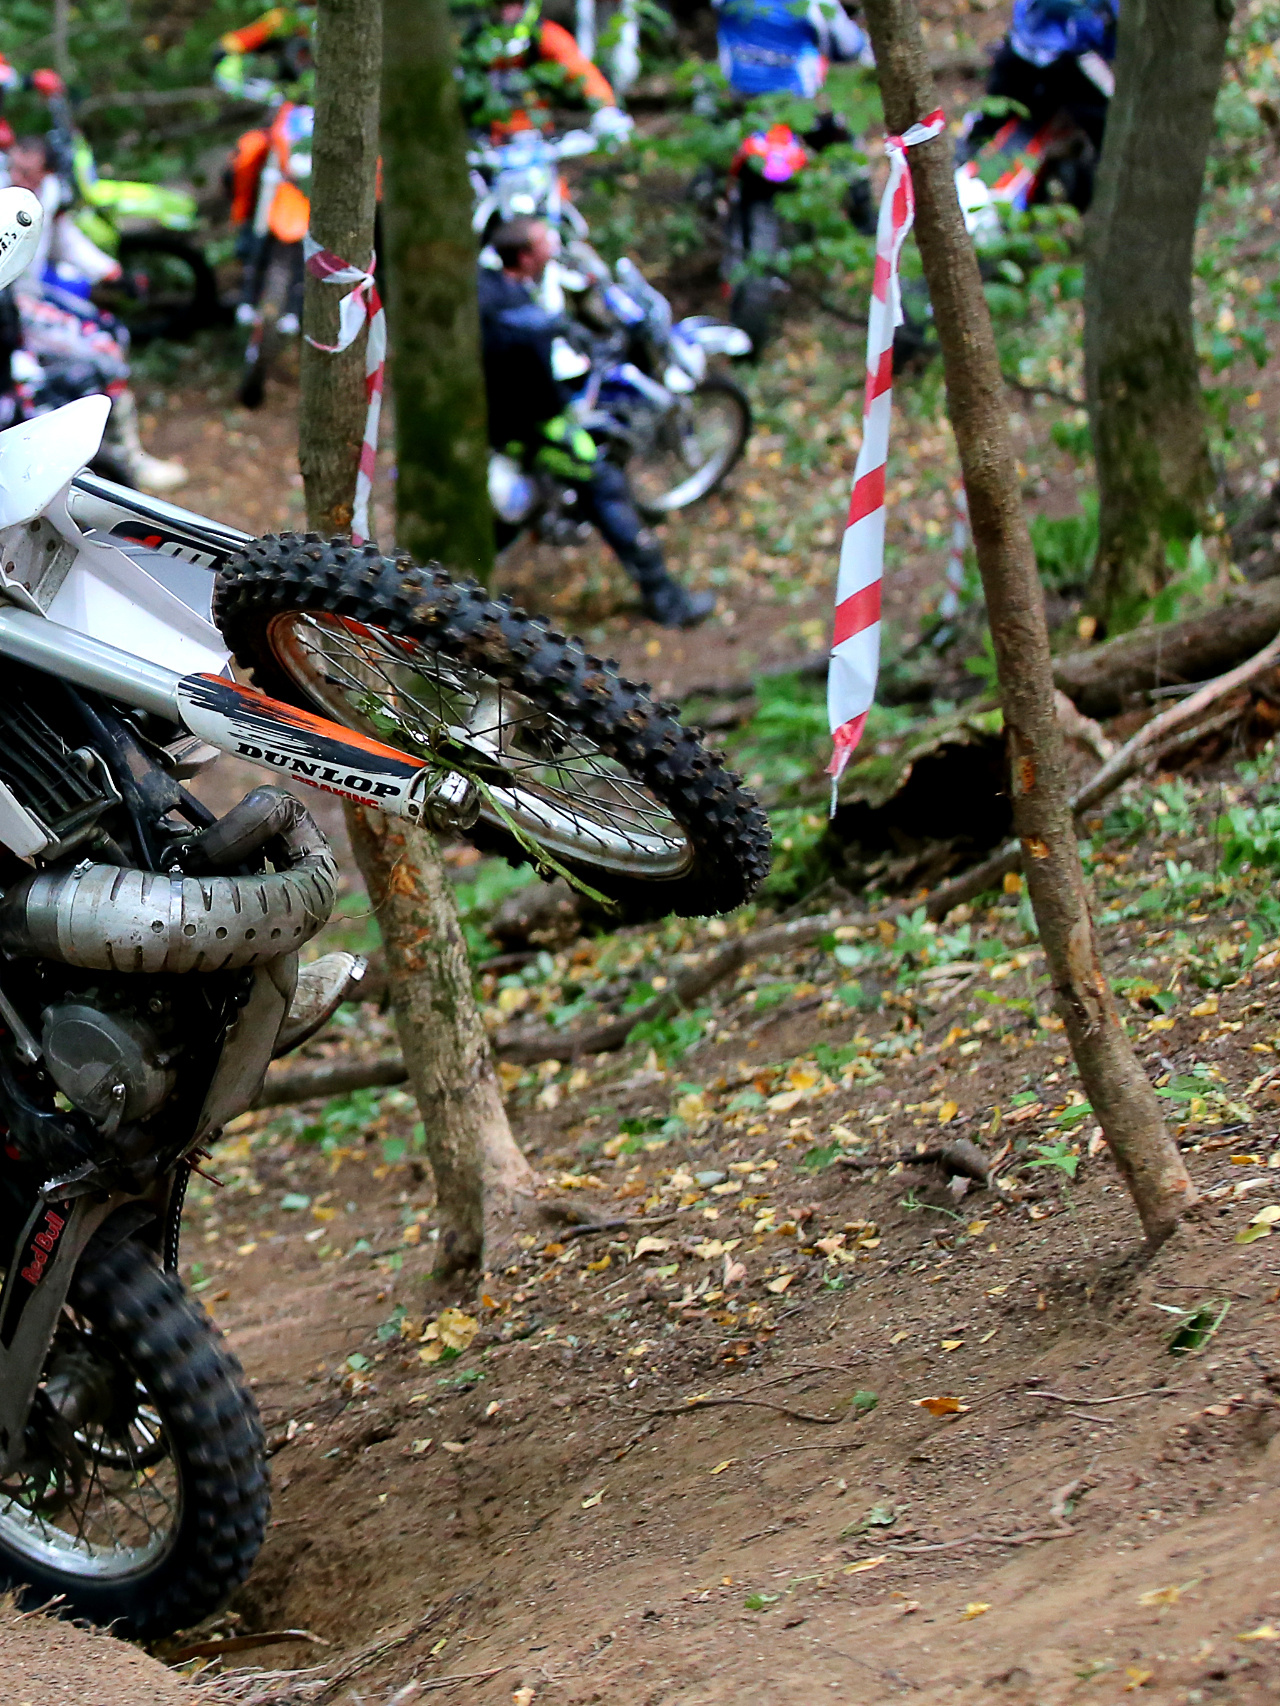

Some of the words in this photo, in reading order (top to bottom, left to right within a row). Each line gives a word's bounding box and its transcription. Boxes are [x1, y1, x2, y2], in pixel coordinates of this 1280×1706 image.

[235, 742, 401, 799] DUNLOP
[21, 1244, 48, 1286] Red
[35, 1209, 65, 1252] Bull
